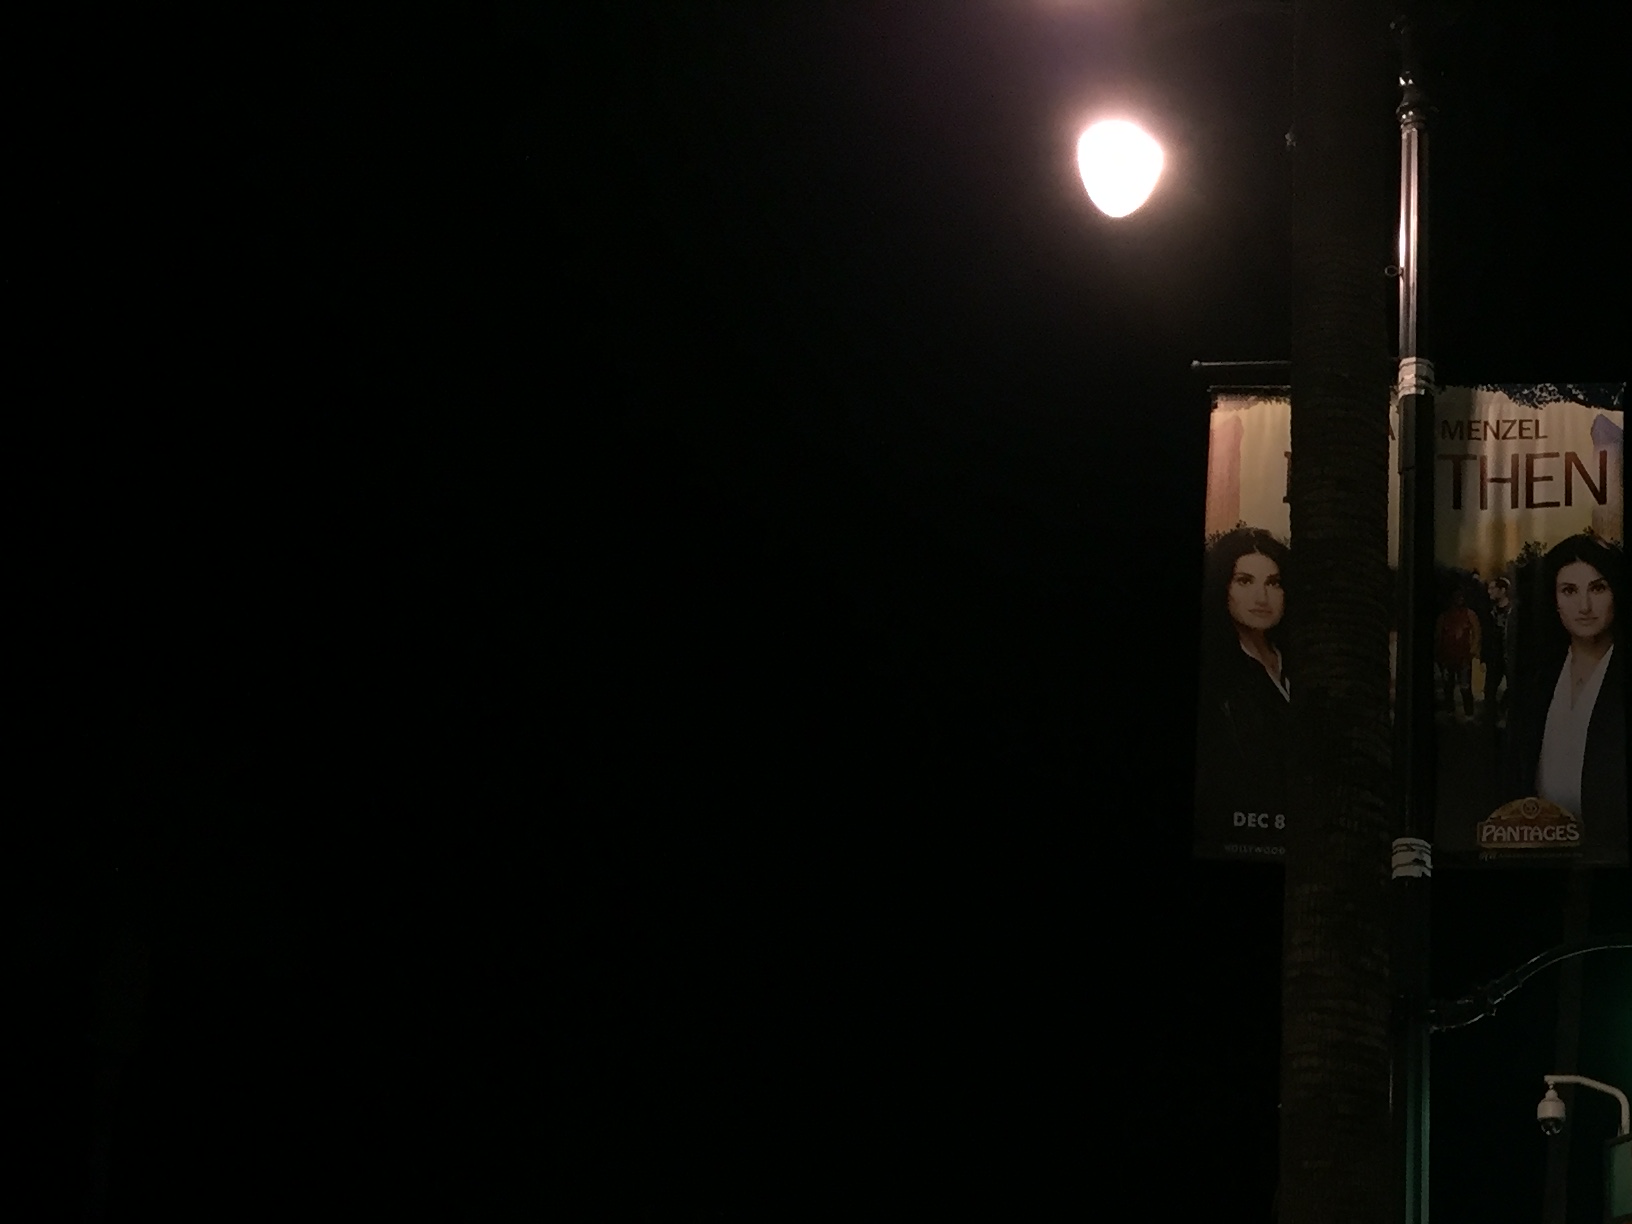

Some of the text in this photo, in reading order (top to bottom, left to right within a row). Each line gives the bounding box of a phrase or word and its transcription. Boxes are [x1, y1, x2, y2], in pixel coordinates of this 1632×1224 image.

[1441, 418, 1548, 441] MENZEL
[1435, 450, 1608, 510] THEN
[1233, 811, 1287, 830] DEC 8
[1480, 823, 1581, 843] PANTAGES
[1224, 843, 1287, 855] HOLLYWOOD
